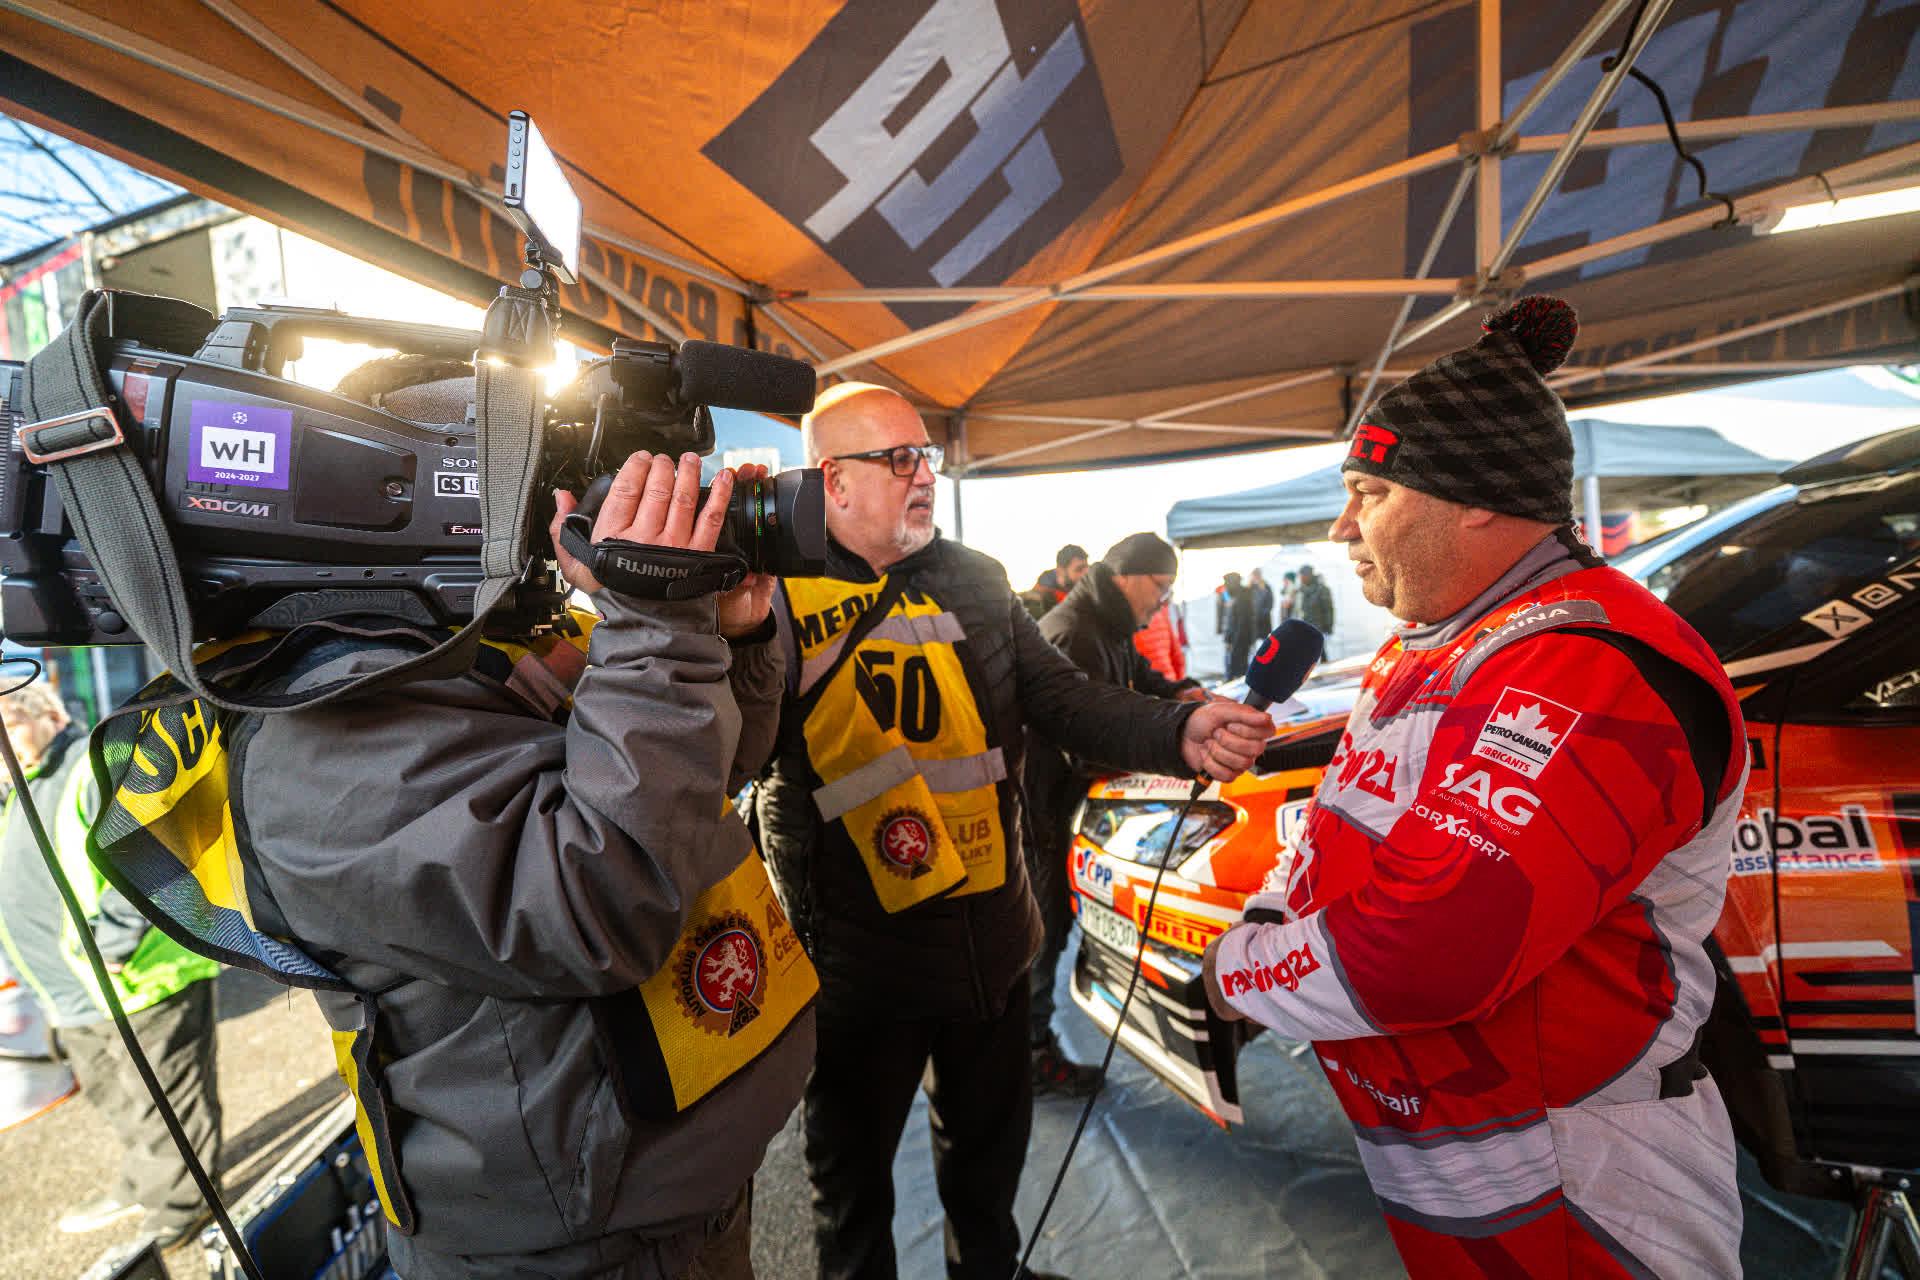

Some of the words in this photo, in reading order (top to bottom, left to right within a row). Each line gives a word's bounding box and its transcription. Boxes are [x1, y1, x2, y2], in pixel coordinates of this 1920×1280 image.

[209, 438, 266, 464] wH
[214, 471, 260, 482] 2024-2027
[440, 477, 461, 492] CS
[186, 496, 270, 517] XDCAM
[616, 555, 690, 580] FUJINON
[856, 650, 941, 743] 50
[1484, 722, 1555, 758] PETRO-CANADA
[1438, 763, 1542, 826] SAG
[1439, 791, 1491, 821] AUTOMOTIVE
[1490, 817, 1522, 839] GROUP
[1732, 806, 1872, 853] obal
